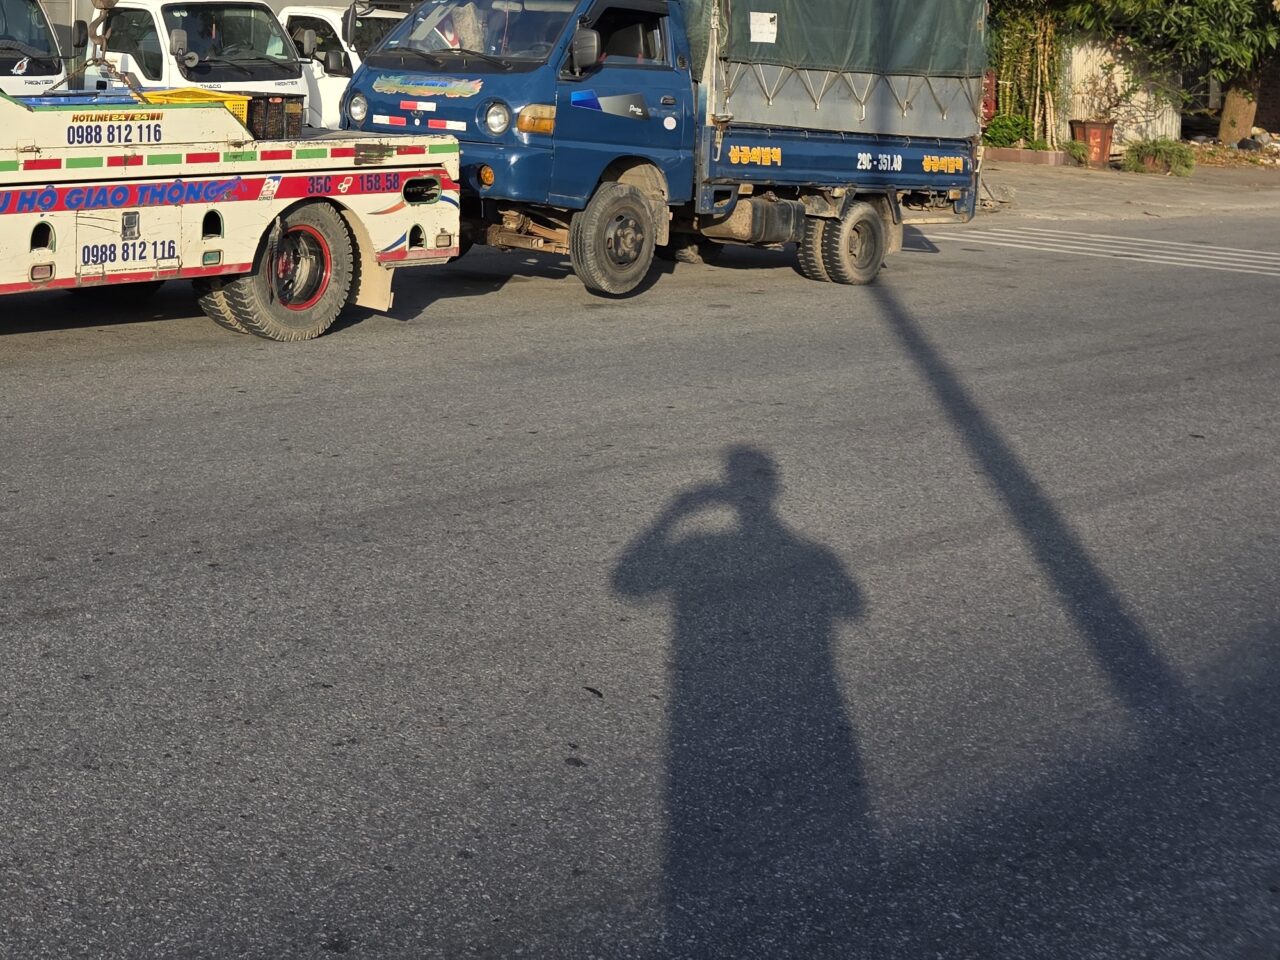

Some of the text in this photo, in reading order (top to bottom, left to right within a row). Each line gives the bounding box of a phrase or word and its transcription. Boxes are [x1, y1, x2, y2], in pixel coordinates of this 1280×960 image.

[72, 113, 110, 123] HOTLINE
[67, 123, 162, 145] 0988 812 116
[856, 152, 872, 170] 29C
[308, 172, 400, 194] 35C 158.58
[17, 185, 58, 217] HỘ
[64, 186, 129, 210] GIAO
[136, 178, 226, 208] THÔNG
[82, 239, 176, 265] 0988 812 116
